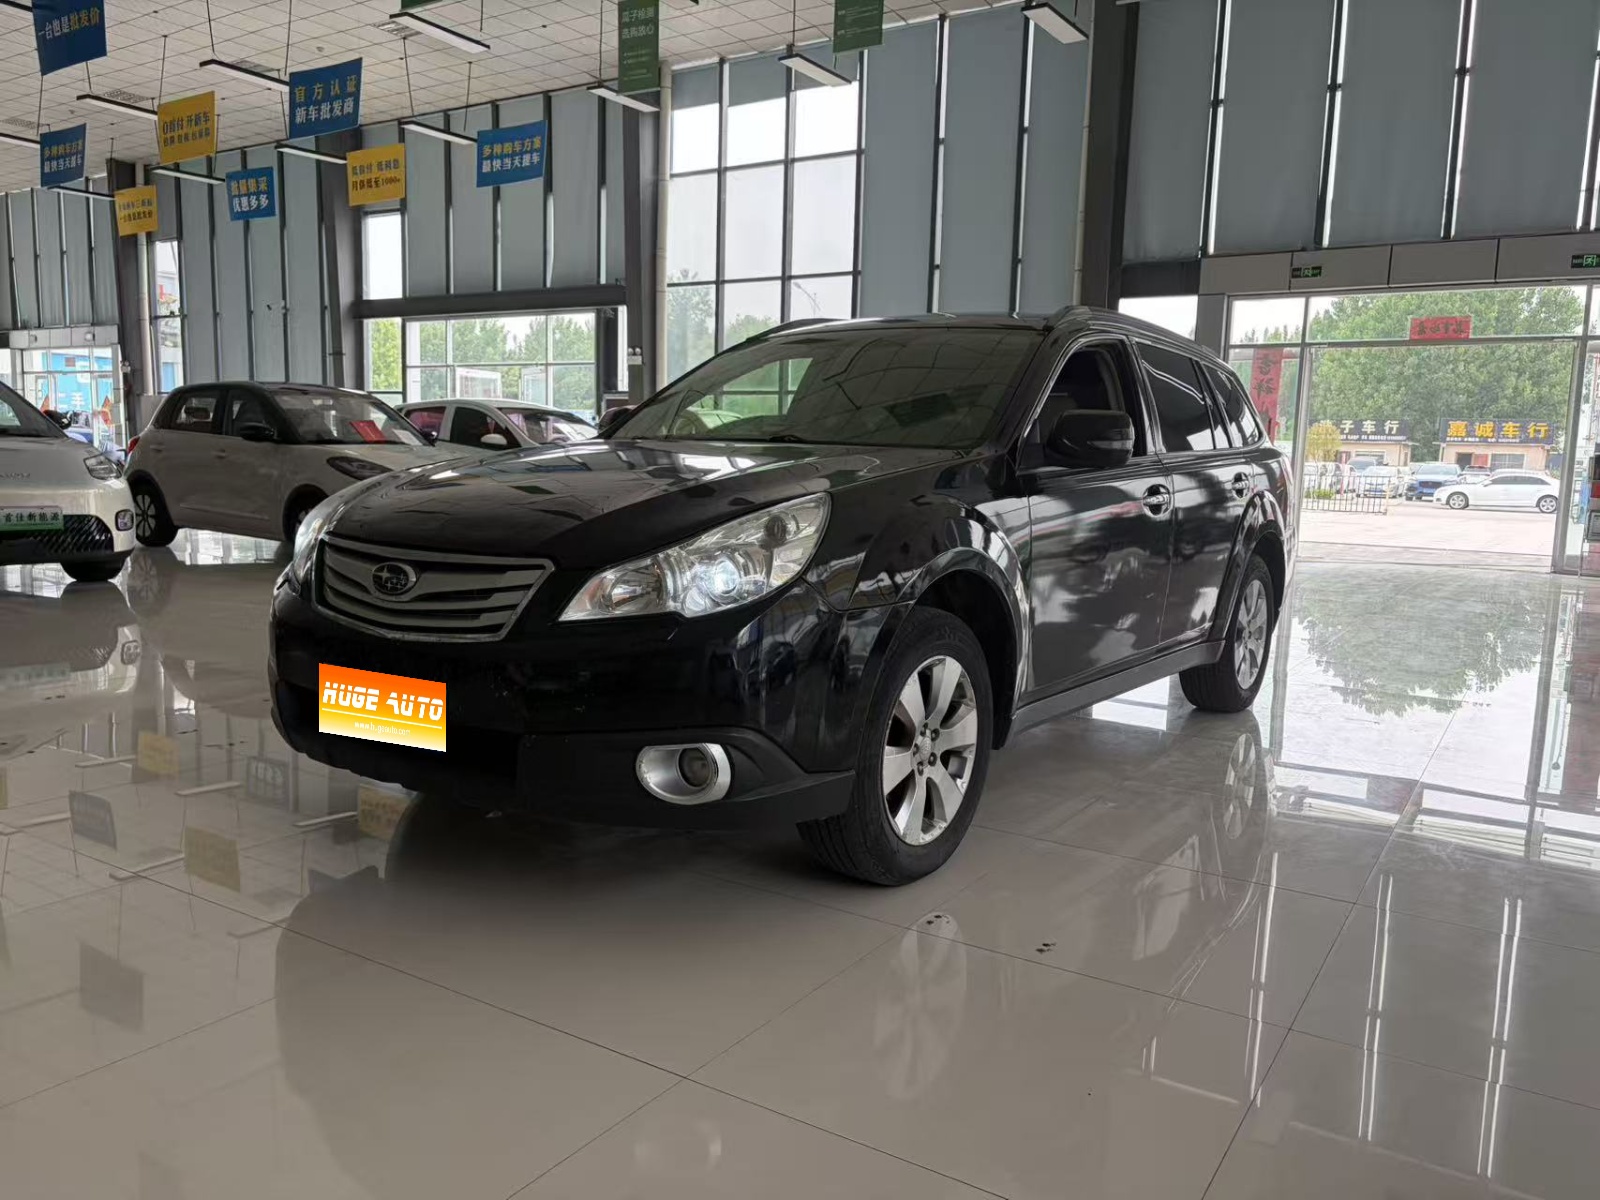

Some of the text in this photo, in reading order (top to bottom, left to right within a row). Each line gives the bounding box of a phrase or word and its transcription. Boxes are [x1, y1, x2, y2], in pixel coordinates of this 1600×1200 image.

[38, 7, 100, 40] 一台也是批发价
[295, 75, 357, 103] 官方认证
[295, 97, 354, 124] 新车批发商
[482, 136, 542, 158] 多种购车方案
[482, 152, 541, 173] 最快当天提车
[232, 193, 269, 213] 优惠多多
[1447, 420, 1549, 438] 嘉诚车行
